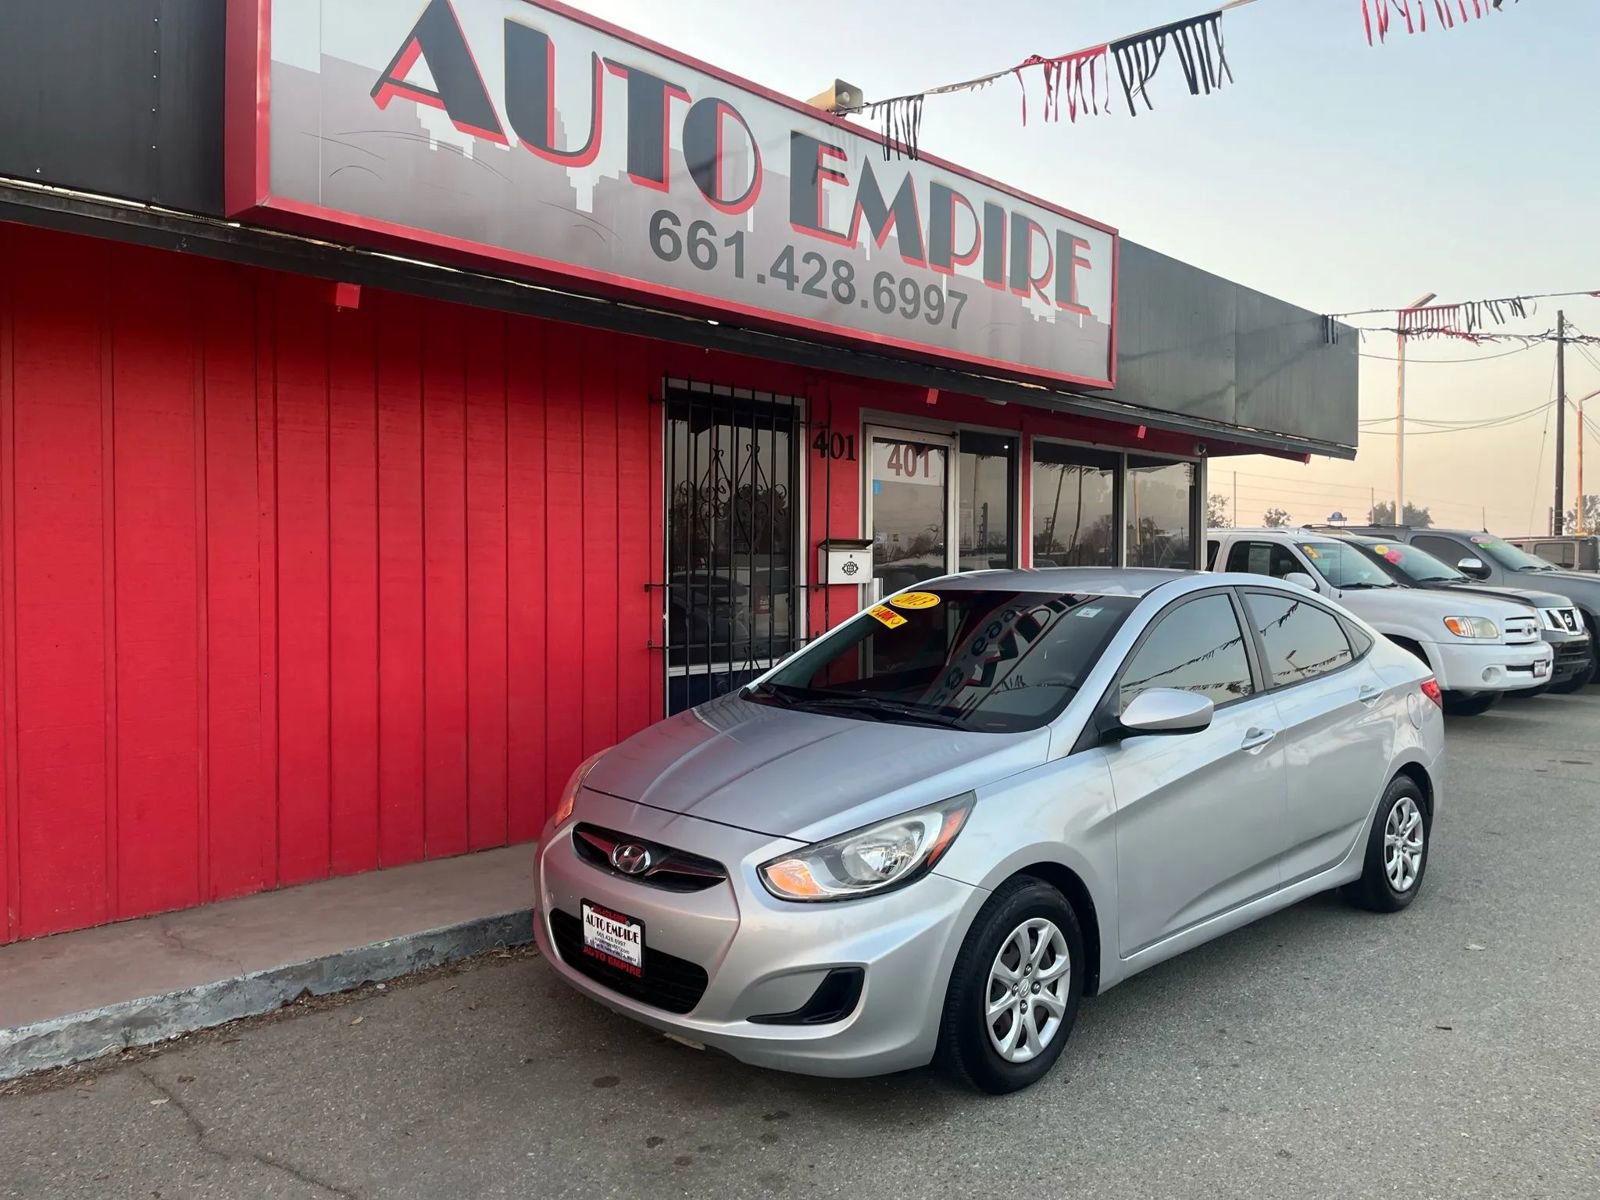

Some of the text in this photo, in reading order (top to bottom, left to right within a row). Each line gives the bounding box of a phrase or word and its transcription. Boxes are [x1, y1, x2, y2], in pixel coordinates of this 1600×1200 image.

[370, 0, 1092, 316] AUTO EMPIRE
[648, 209, 968, 330] 661.428.6997
[812, 430, 856, 461] 401
[887, 444, 929, 478] 401
[586, 913, 605, 931] AUTO
[606, 922, 639, 944] EMPIRE
